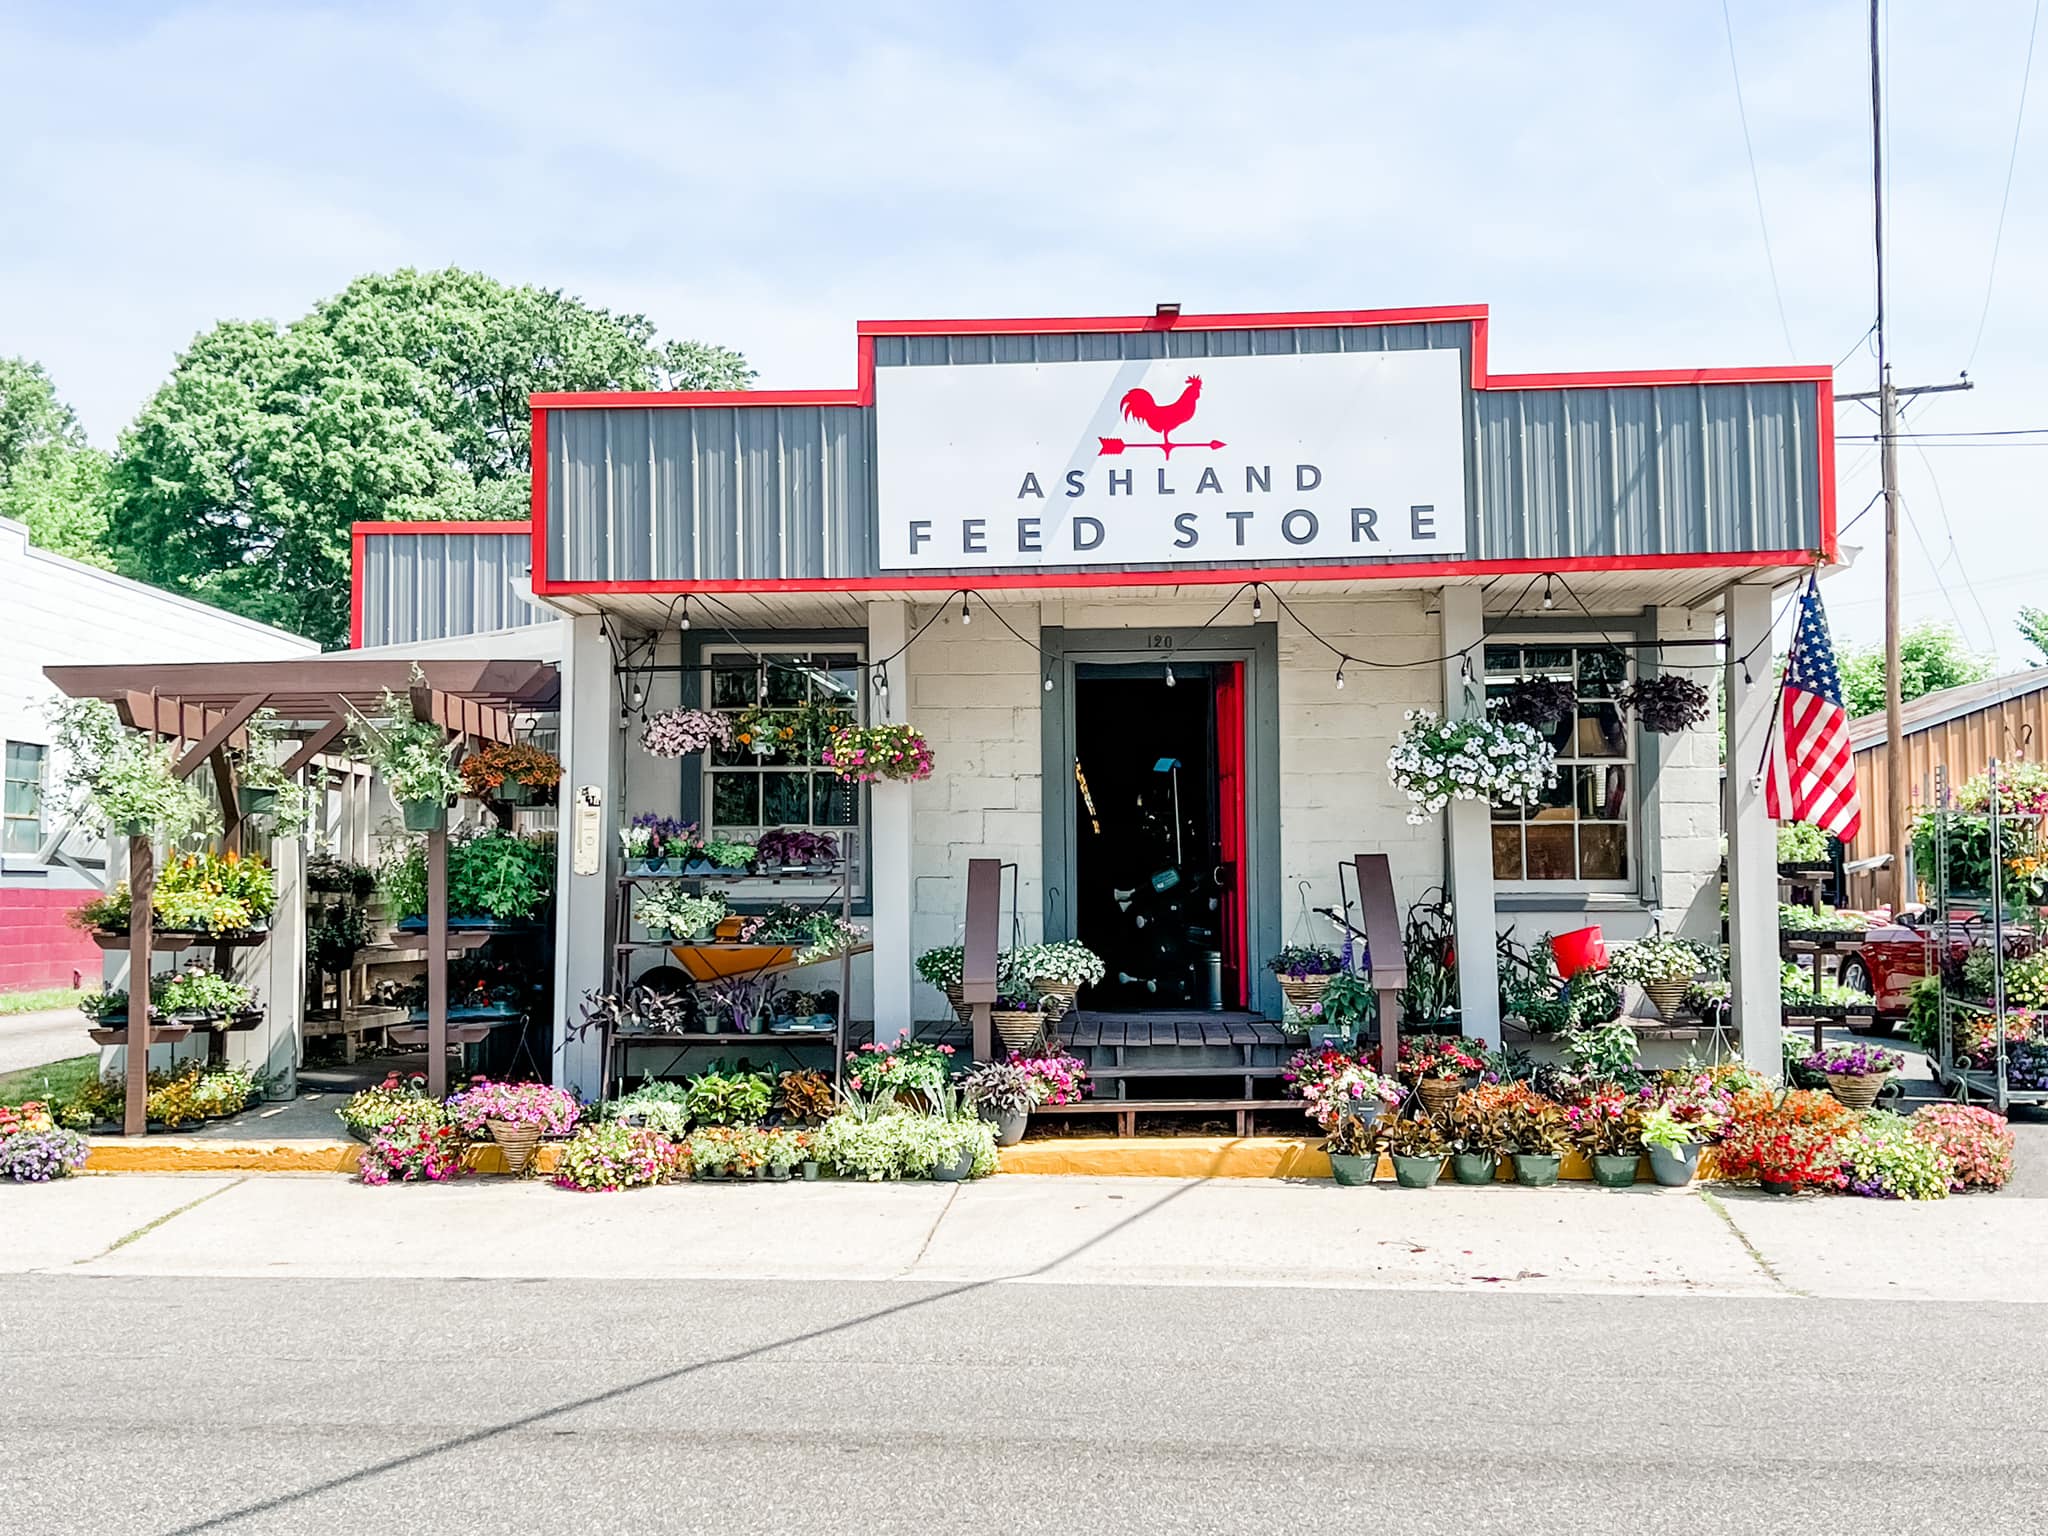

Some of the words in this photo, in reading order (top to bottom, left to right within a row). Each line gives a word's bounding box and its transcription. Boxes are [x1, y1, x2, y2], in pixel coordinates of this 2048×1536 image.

[1017, 464, 1323, 499] ASHLAND
[909, 516, 1106, 555] FEED
[1173, 504, 1437, 549] STORE
[1148, 634, 1173, 648] 120
